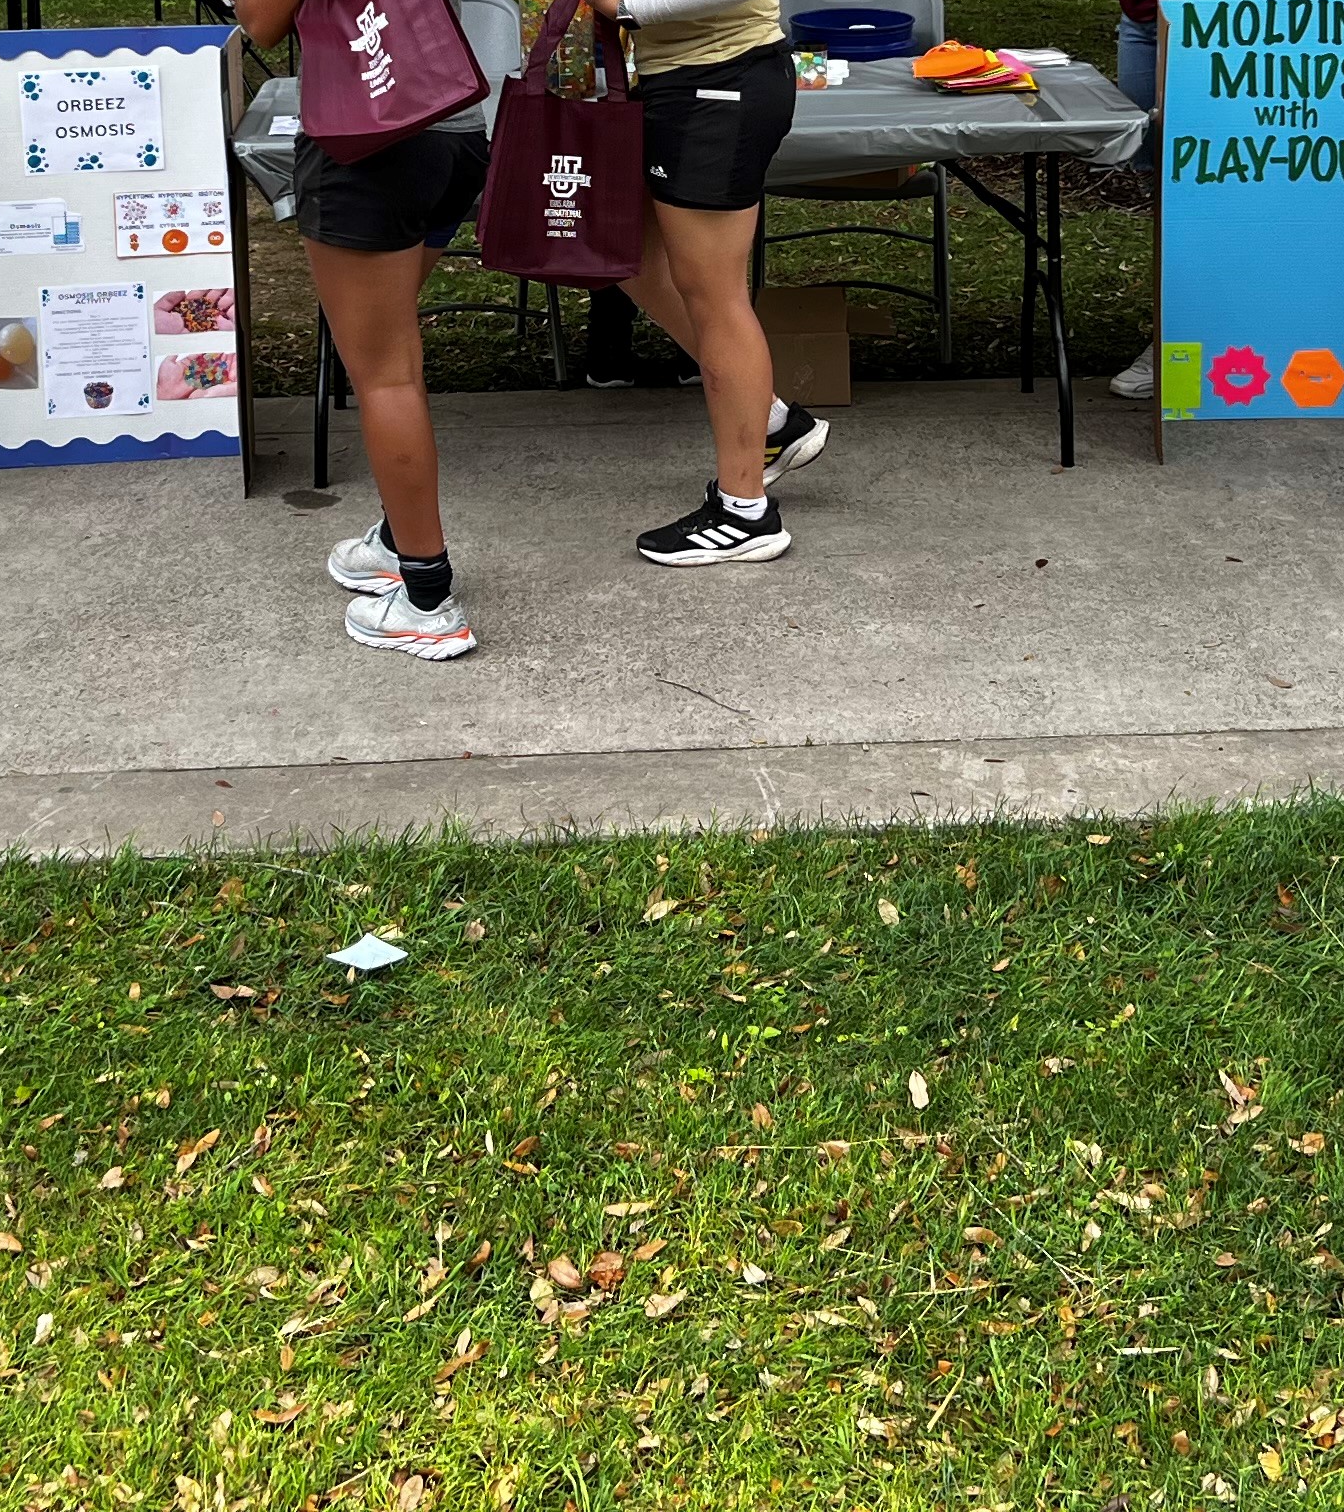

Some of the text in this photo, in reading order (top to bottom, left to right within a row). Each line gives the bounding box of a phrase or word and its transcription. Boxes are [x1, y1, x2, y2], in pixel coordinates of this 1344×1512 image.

[56, 97, 126, 114] ORBEEZ
[1253, 98, 1320, 129] with
[55, 123, 136, 139] OSMOSIS
[58, 290, 128, 301] OSMOSIS ORBEEZ
[75, 297, 112, 305] ACTIVITY
